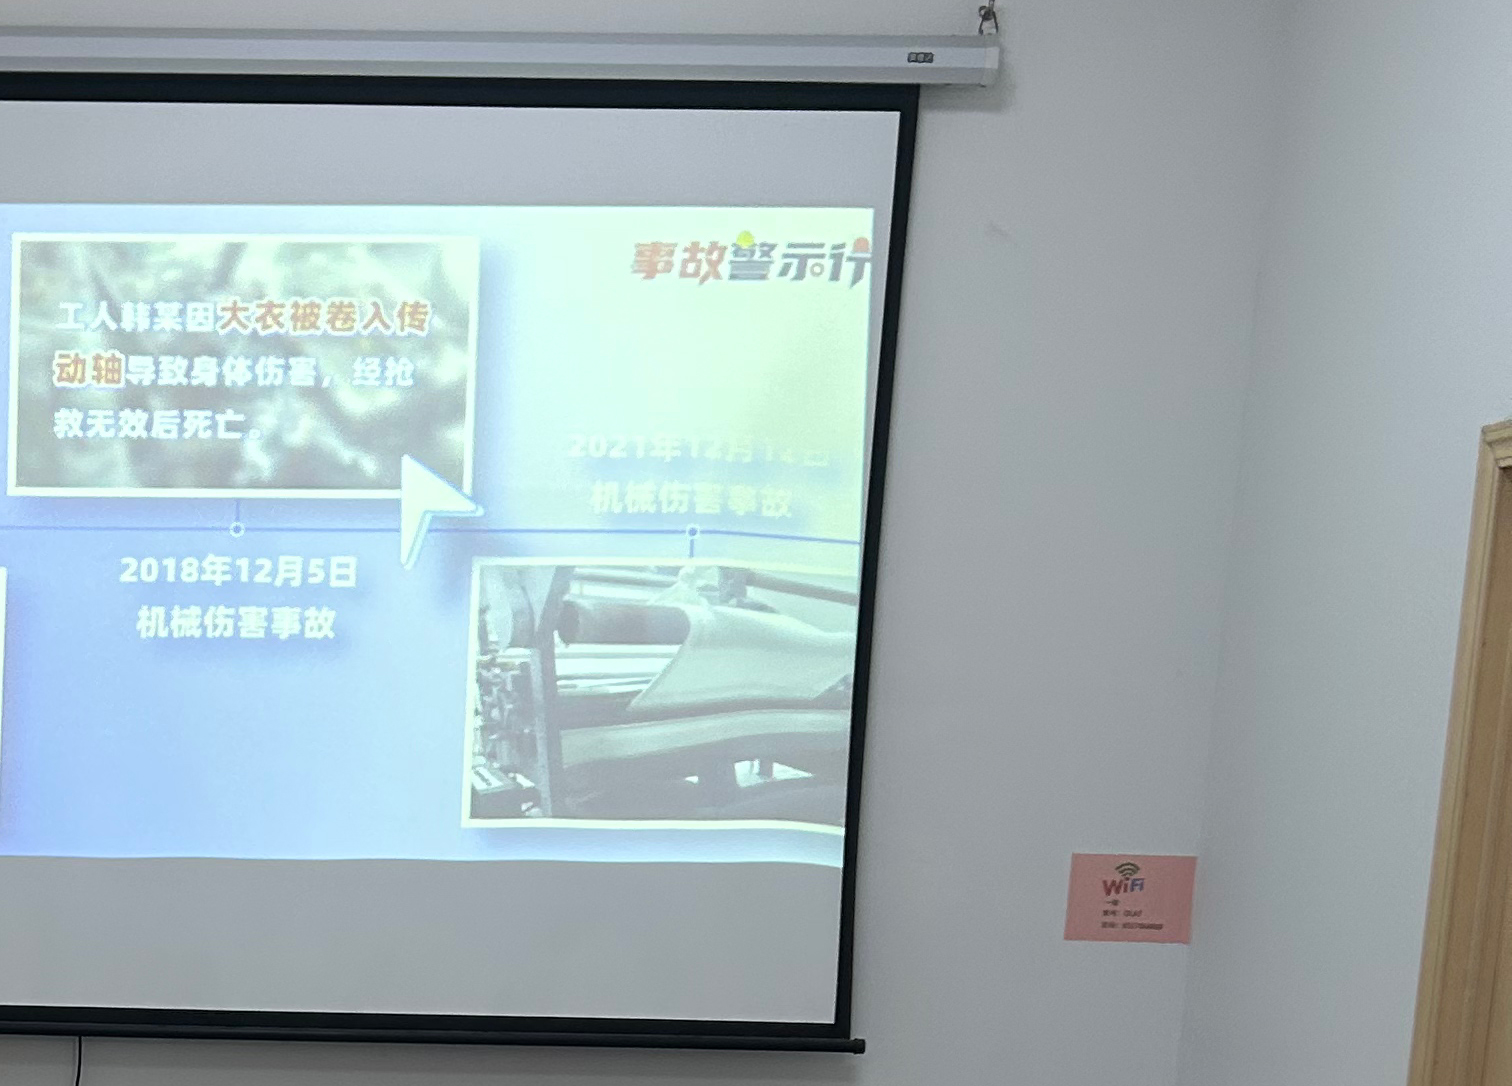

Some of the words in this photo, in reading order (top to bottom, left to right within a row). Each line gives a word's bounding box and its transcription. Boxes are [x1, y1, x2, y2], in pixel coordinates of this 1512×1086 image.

[631, 239, 872, 289] 事故警示行
[55, 297, 432, 335] 工人韩某因大衣被卷入传
[52, 407, 263, 441] 救无效后死亡。
[118, 553, 358, 588] 2018年12月5日
[136, 604, 337, 640] 机械伤害事故
[1102, 877, 1145, 897] WiFi
